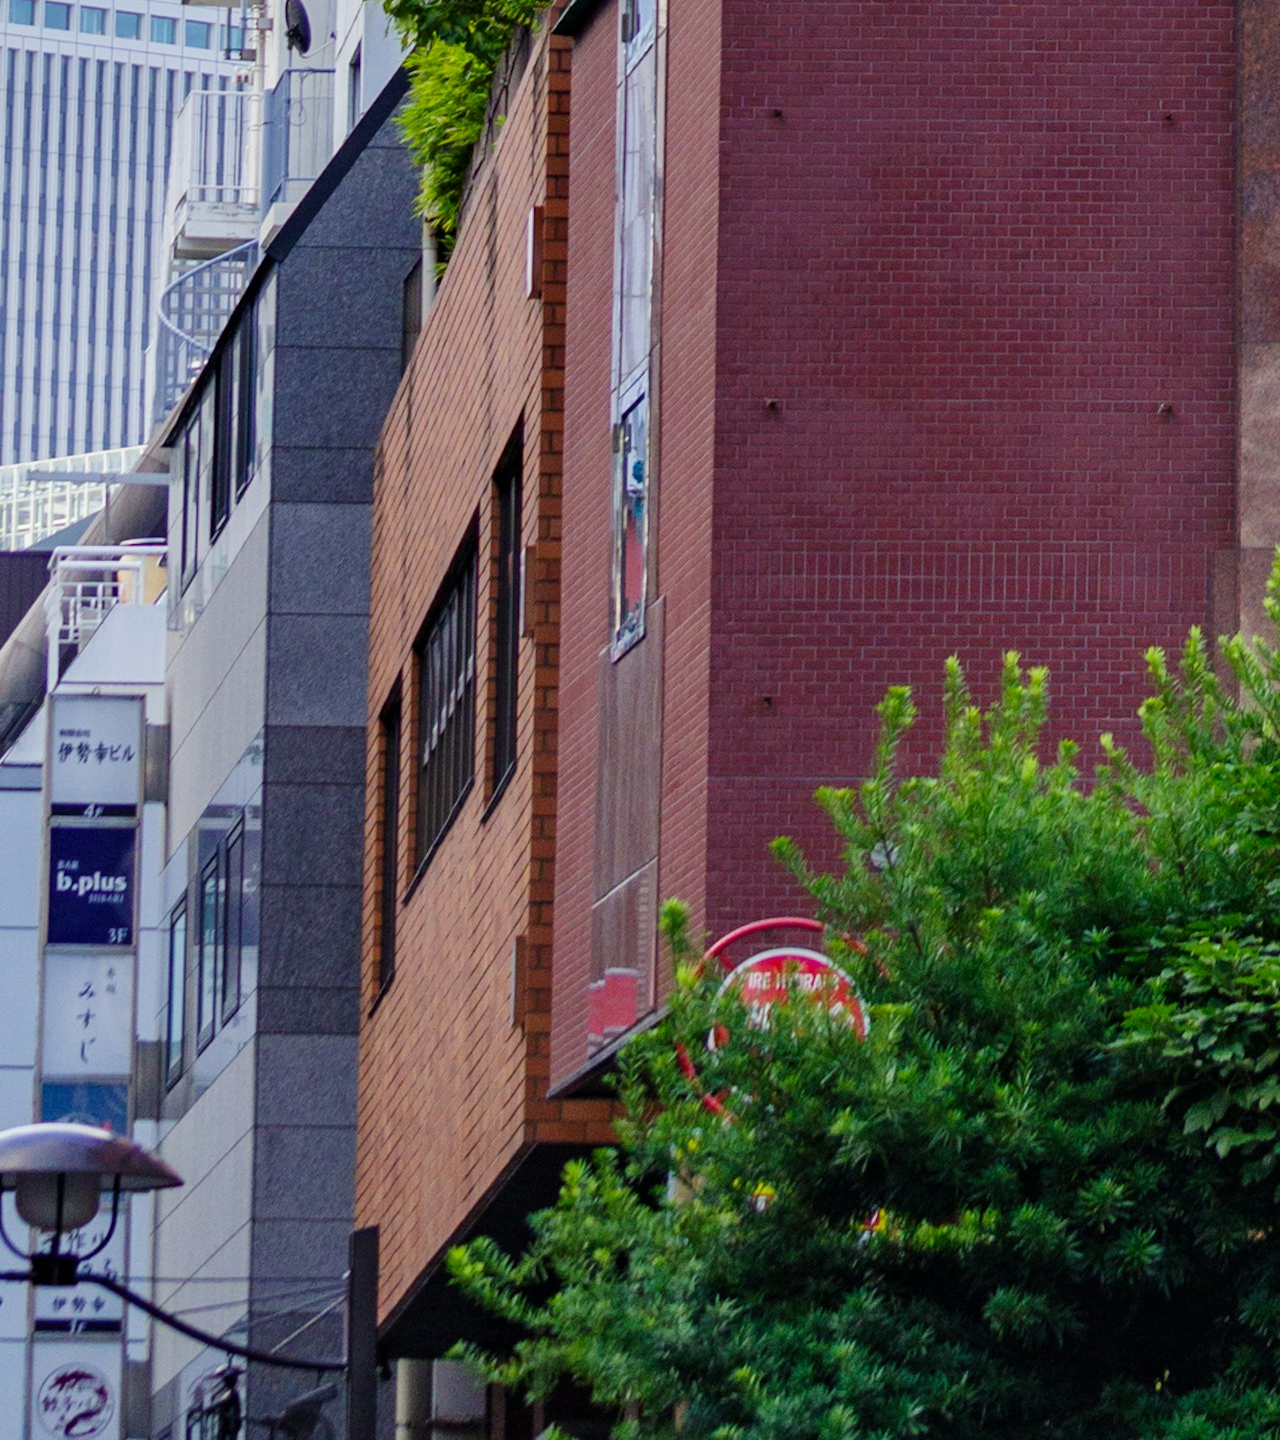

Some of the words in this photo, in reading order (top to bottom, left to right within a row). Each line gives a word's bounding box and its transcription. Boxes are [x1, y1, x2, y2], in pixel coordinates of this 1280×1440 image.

[56, 870, 128, 897] b.plus
[108, 927, 129, 944] 3F
[76, 981, 97, 1063] みすじ
